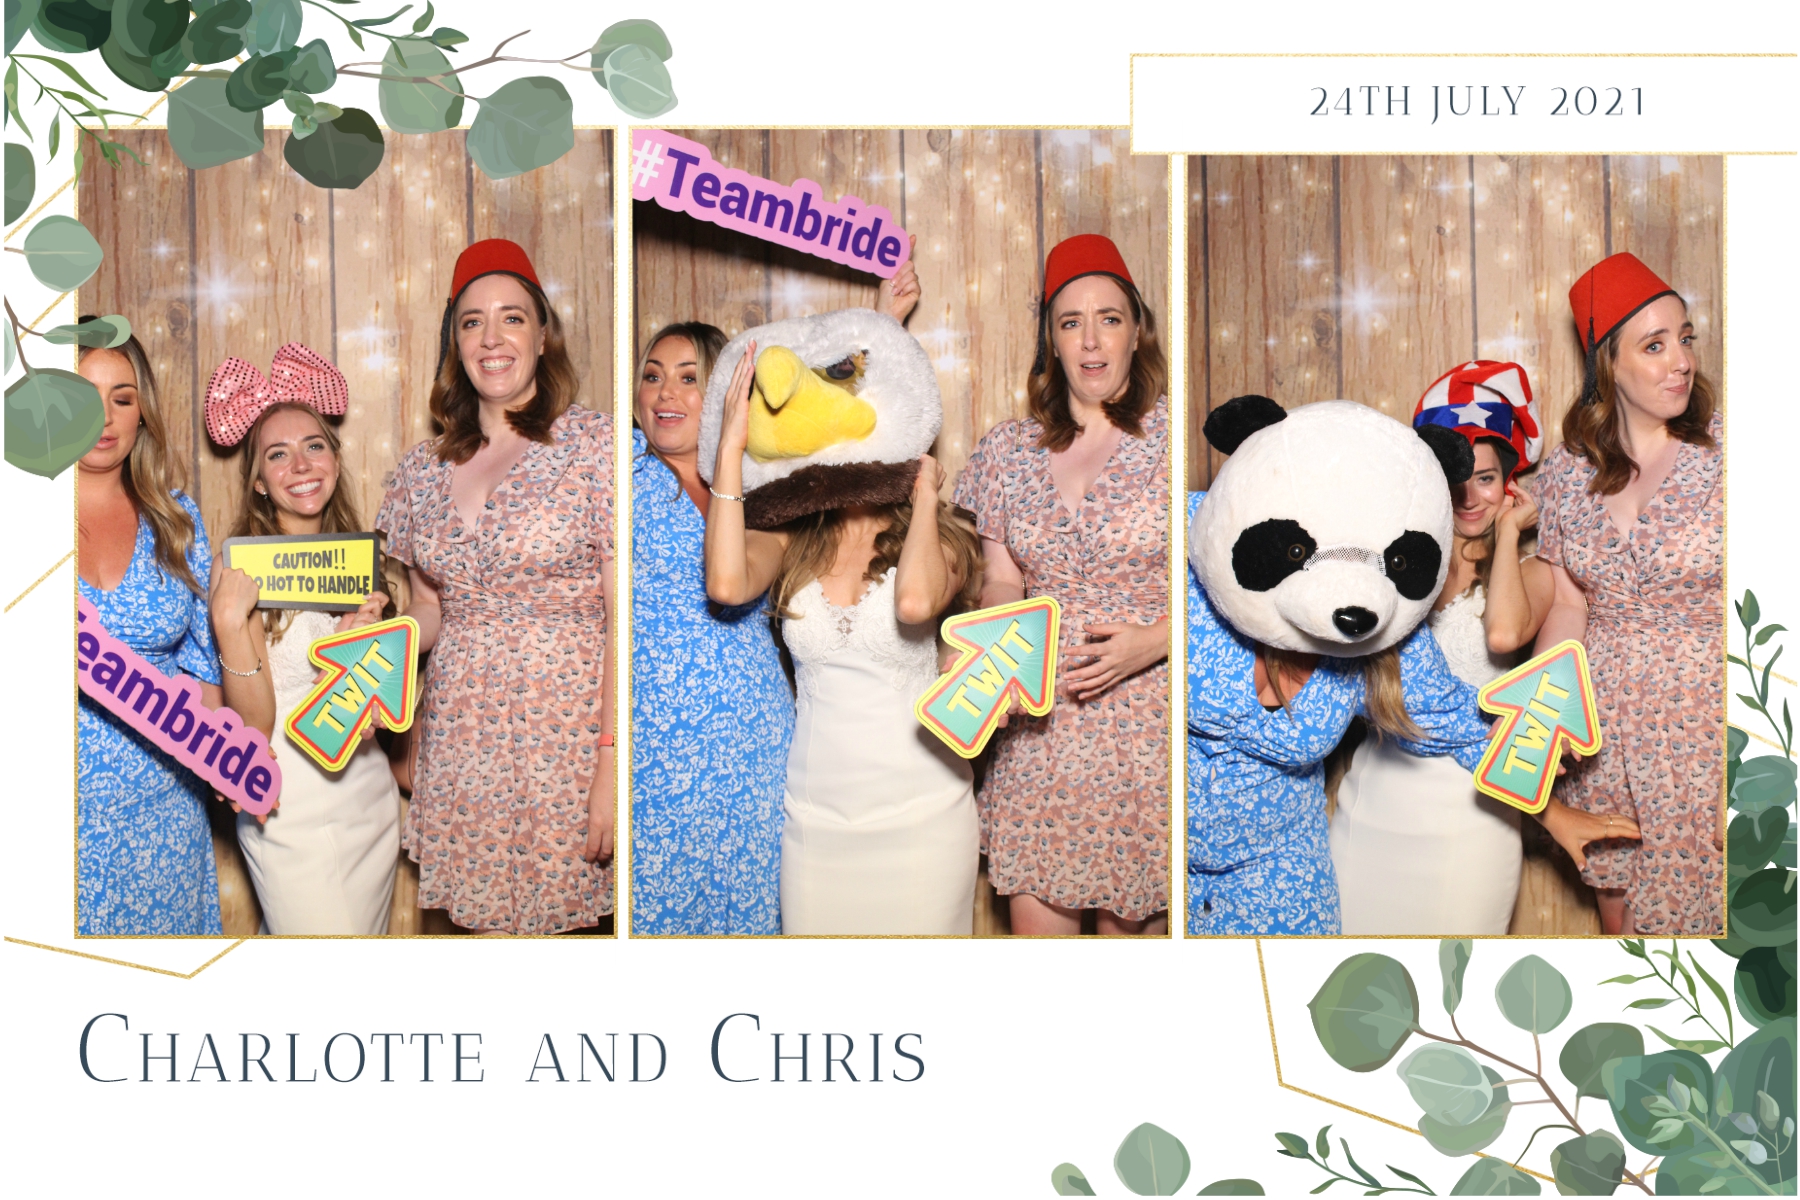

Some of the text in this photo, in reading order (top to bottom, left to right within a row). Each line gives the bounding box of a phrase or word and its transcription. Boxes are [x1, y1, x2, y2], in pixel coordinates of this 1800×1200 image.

[632, 139, 902, 268] #Teambride
[266, 575, 294, 592] HOT
[297, 575, 315, 593] TO
[318, 575, 370, 596] HANDLE
[273, 548, 346, 570] CAUTION!!
[78, 609, 272, 802] eambride
[312, 639, 394, 734] TWIT
[946, 619, 1035, 718] TWIT
[1502, 671, 1570, 775] TWIT
